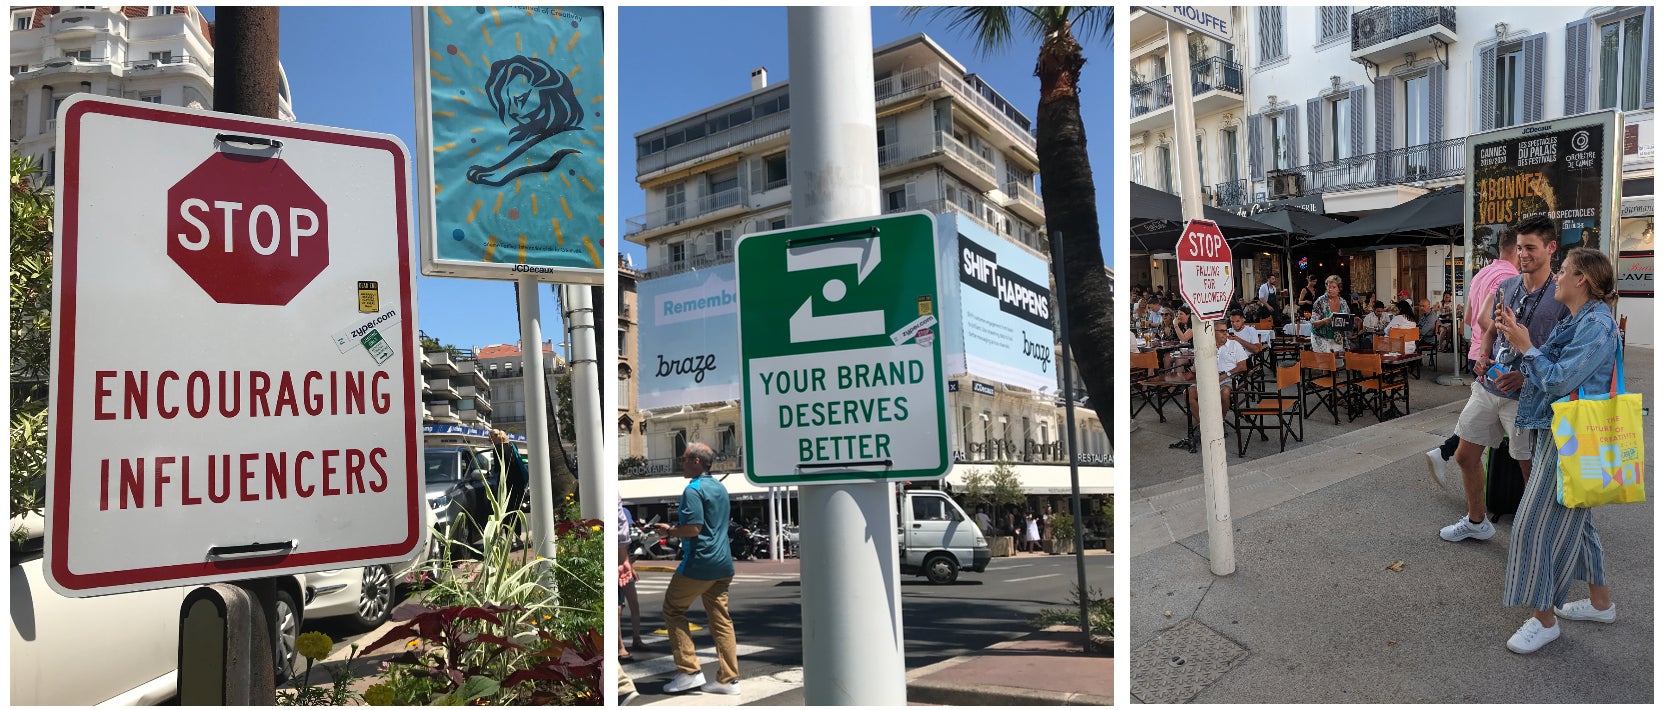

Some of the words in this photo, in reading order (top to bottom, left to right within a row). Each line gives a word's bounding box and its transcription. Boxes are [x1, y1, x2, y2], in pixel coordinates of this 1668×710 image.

[1173, 6, 1228, 34] RIOUFFE
[1521, 125, 1552, 135] JCDecaux
[1480, 145, 1507, 159] CANNES
[1518, 141, 1528, 149] LES
[1528, 136, 1558, 147] SPECTACLES
[1518, 148, 1529, 159] DU
[1530, 144, 1557, 158] PALAIS
[1517, 158, 1528, 166] DES
[1529, 155, 1557, 165] FESTIVALS
[1565, 151, 1596, 162] ORCHESTRE
[1479, 172, 1543, 202] ABONNEZ
[1479, 200, 1513, 225] VOUS
[1556, 207, 1595, 219] SPECTACLES
[177, 197, 320, 258] STOP
[1188, 231, 1222, 258] STOP
[511, 264, 554, 274] JCDecaux
[963, 247, 998, 288] SHIFT
[1195, 265, 1220, 276] FALLING
[1203, 278, 1216, 290] FOR
[996, 274, 1049, 320] HAPPENS
[1193, 291, 1227, 304] FOLLOWERS
[350, 309, 397, 338] zyper.com
[1022, 330, 1051, 373] braze
[655, 354, 717, 383] braze
[759, 367, 826, 396] YOUR
[837, 359, 925, 390] BRAND
[94, 370, 391, 420] ENCOURAGING
[779, 396, 909, 428] DESERVES
[1586, 425, 1613, 433] FUTURE
[1600, 432, 1636, 443] CREATIVITY
[799, 434, 891, 462] BETTER
[953, 450, 966, 462] AR
[1077, 453, 1114, 464] RESTAURA
[99, 447, 388, 511] INFLUENCERS
